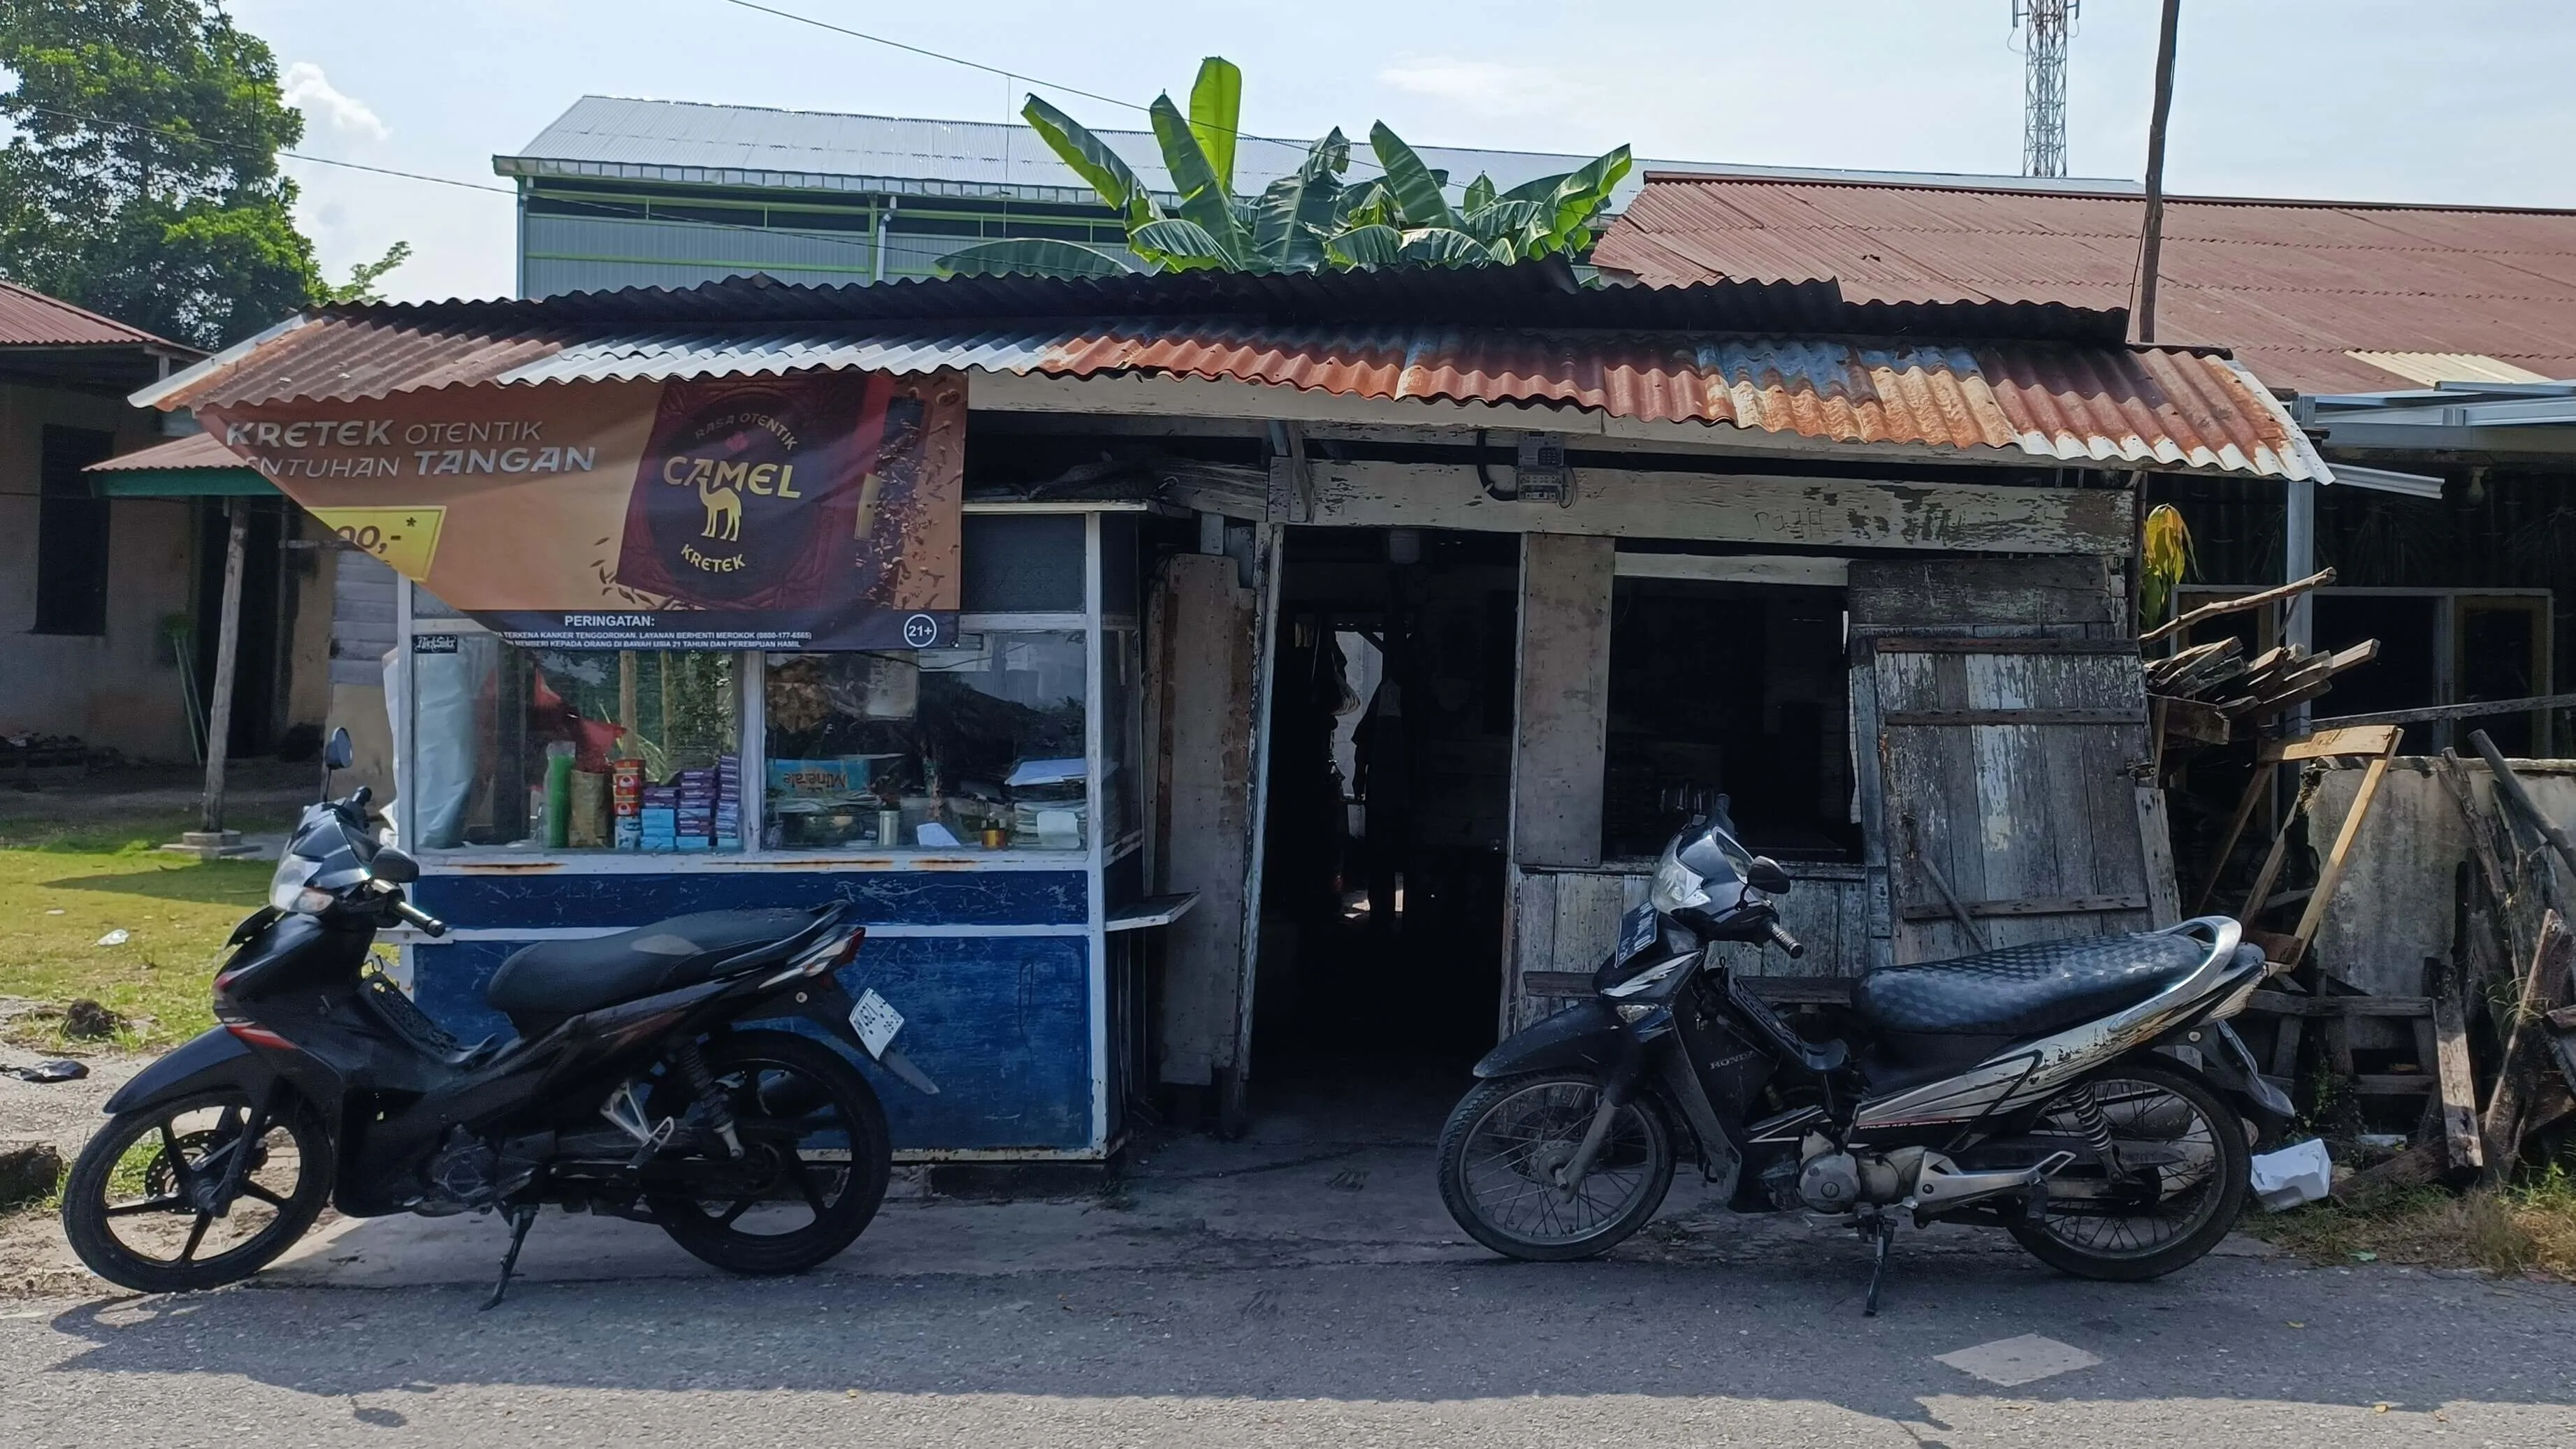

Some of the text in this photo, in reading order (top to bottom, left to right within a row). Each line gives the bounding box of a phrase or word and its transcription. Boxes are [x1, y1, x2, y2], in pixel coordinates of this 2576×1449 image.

[226, 419, 543, 448] KRETEK OTENTIK
[694, 412, 798, 451] RASA OTENTIK
[414, 446, 596, 476] TANGAN
[663, 456, 802, 499] CAMEL
[681, 544, 746, 572] KRETEK
[565, 616, 656, 627] PERINGATAN:
[909, 625, 933, 636] 21+
[783, 772, 848, 789] Minerale
